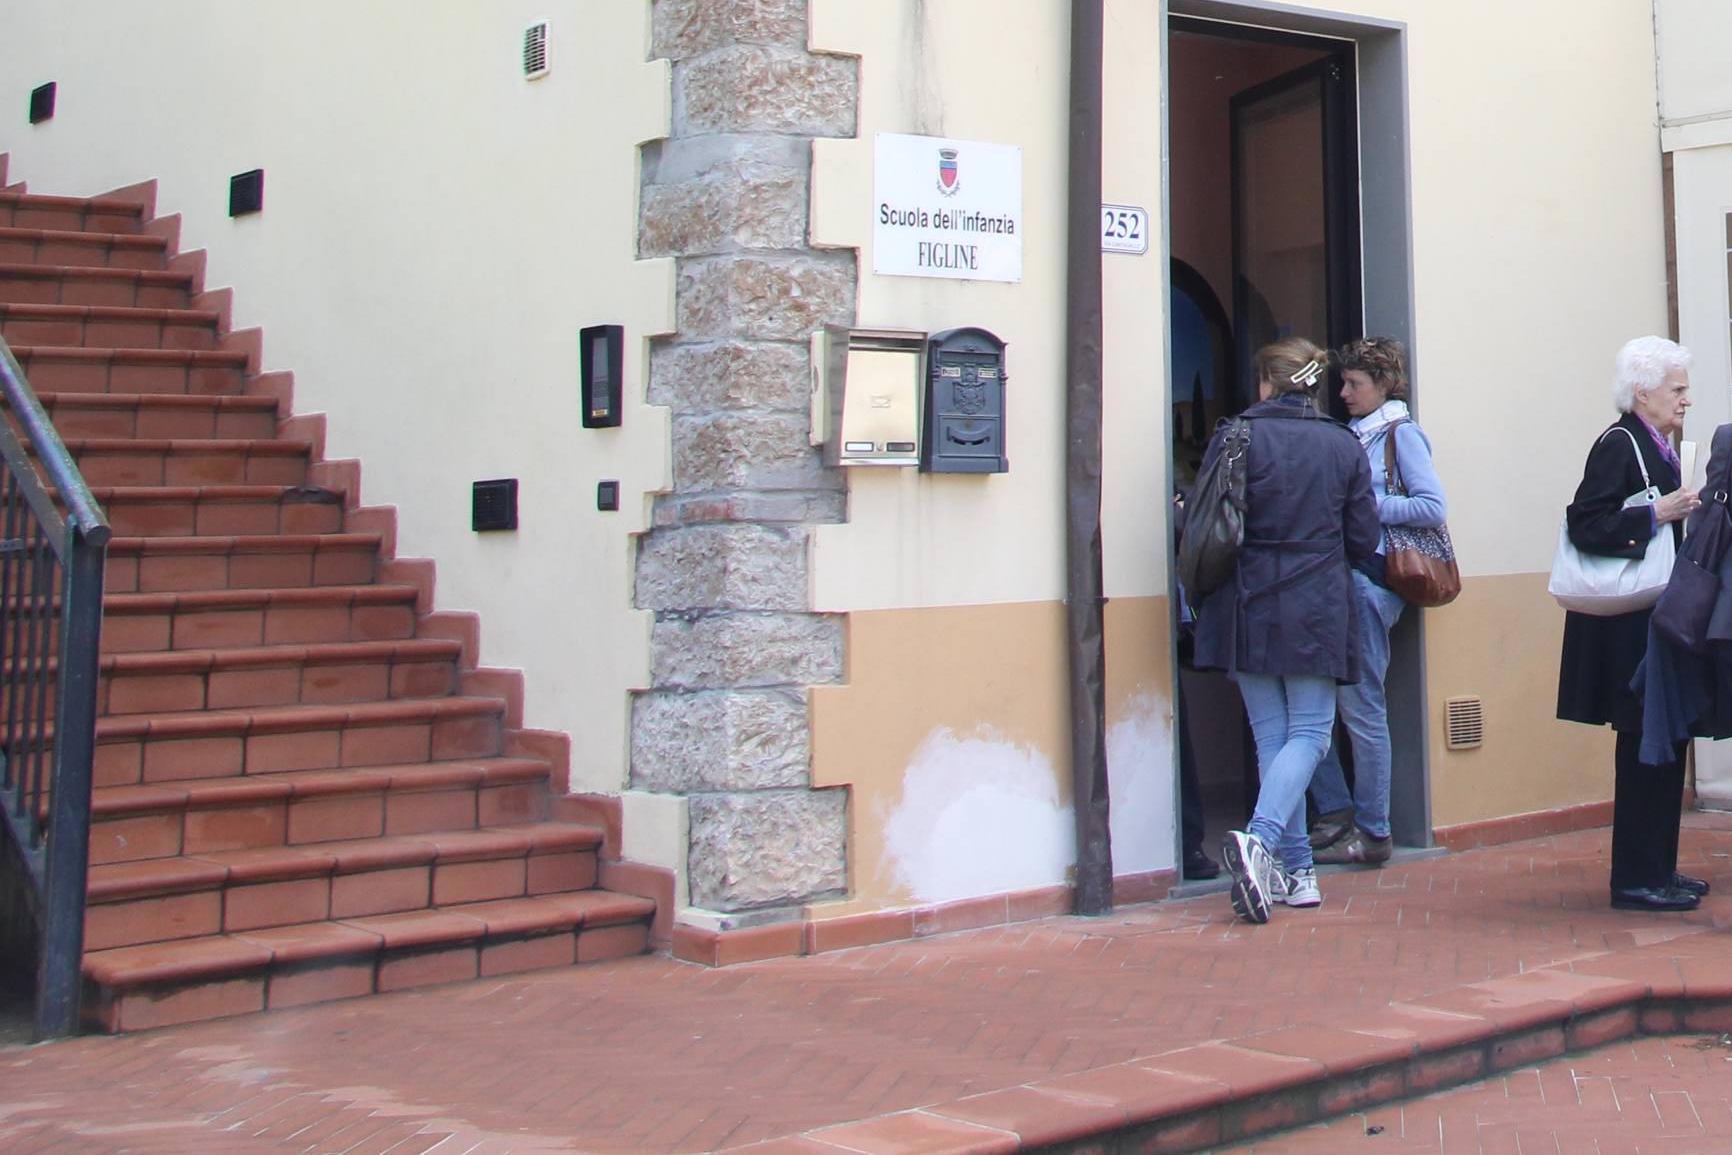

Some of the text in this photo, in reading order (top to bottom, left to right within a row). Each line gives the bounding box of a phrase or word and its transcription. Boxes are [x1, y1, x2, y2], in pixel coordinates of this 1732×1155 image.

[880, 203, 1014, 234] Scuola dell'infanzia
[1104, 211, 1139, 239] 252
[918, 242, 978, 269] FIGLINE
